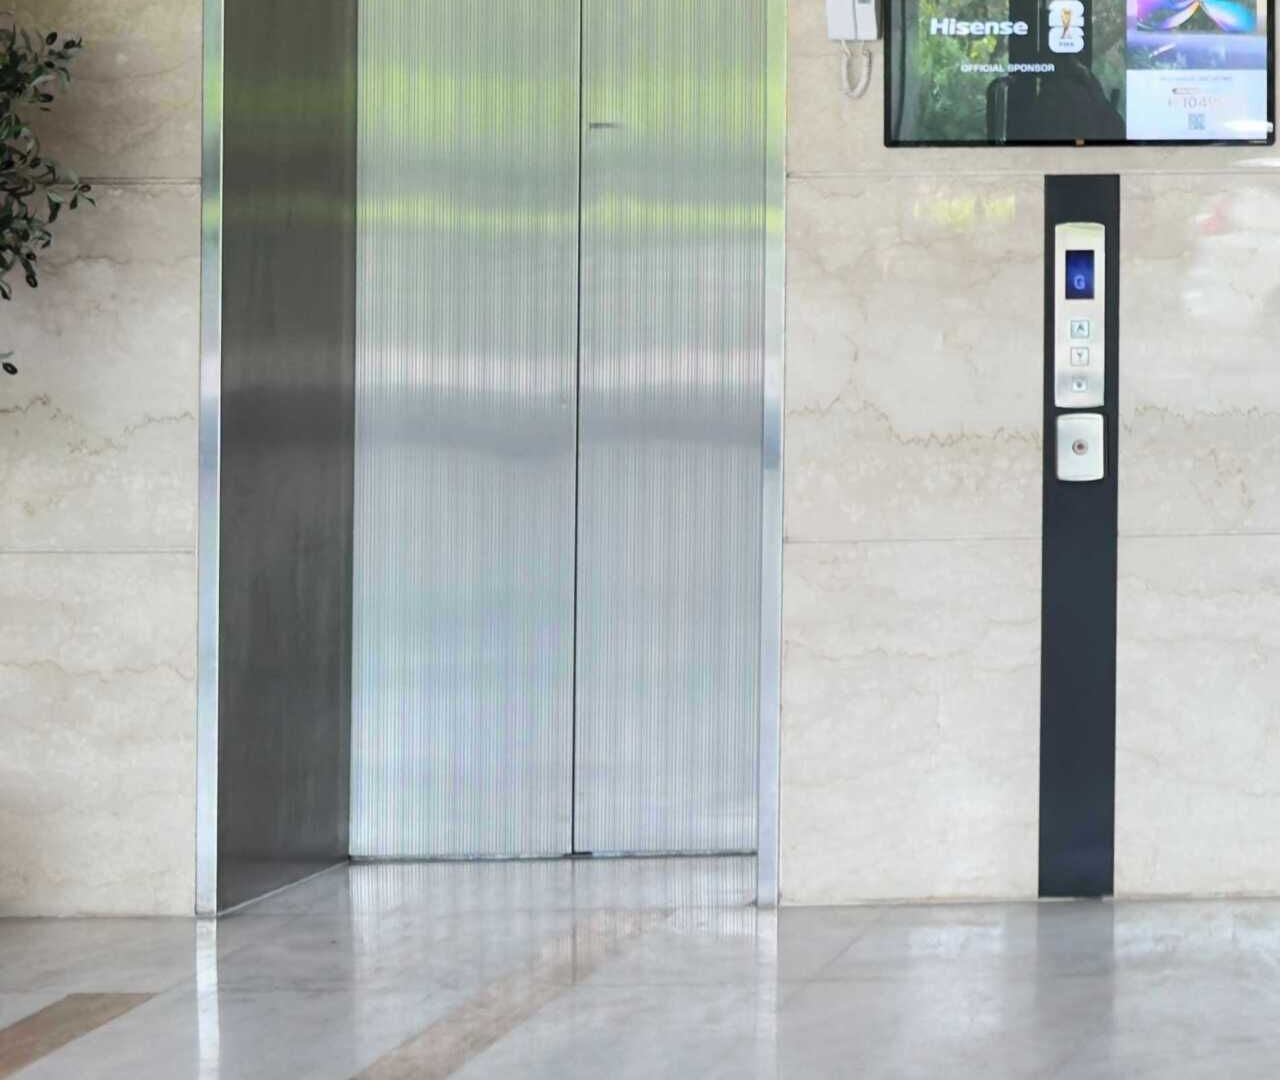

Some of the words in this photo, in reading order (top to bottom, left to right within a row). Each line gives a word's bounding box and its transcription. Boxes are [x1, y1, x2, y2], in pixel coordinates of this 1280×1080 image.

[930, 17, 1029, 36] Hisense
[960, 63, 1004, 73] OFFICIAL
[1007, 63, 1055, 73] SPONSOR
[1073, 274, 1086, 290] G
